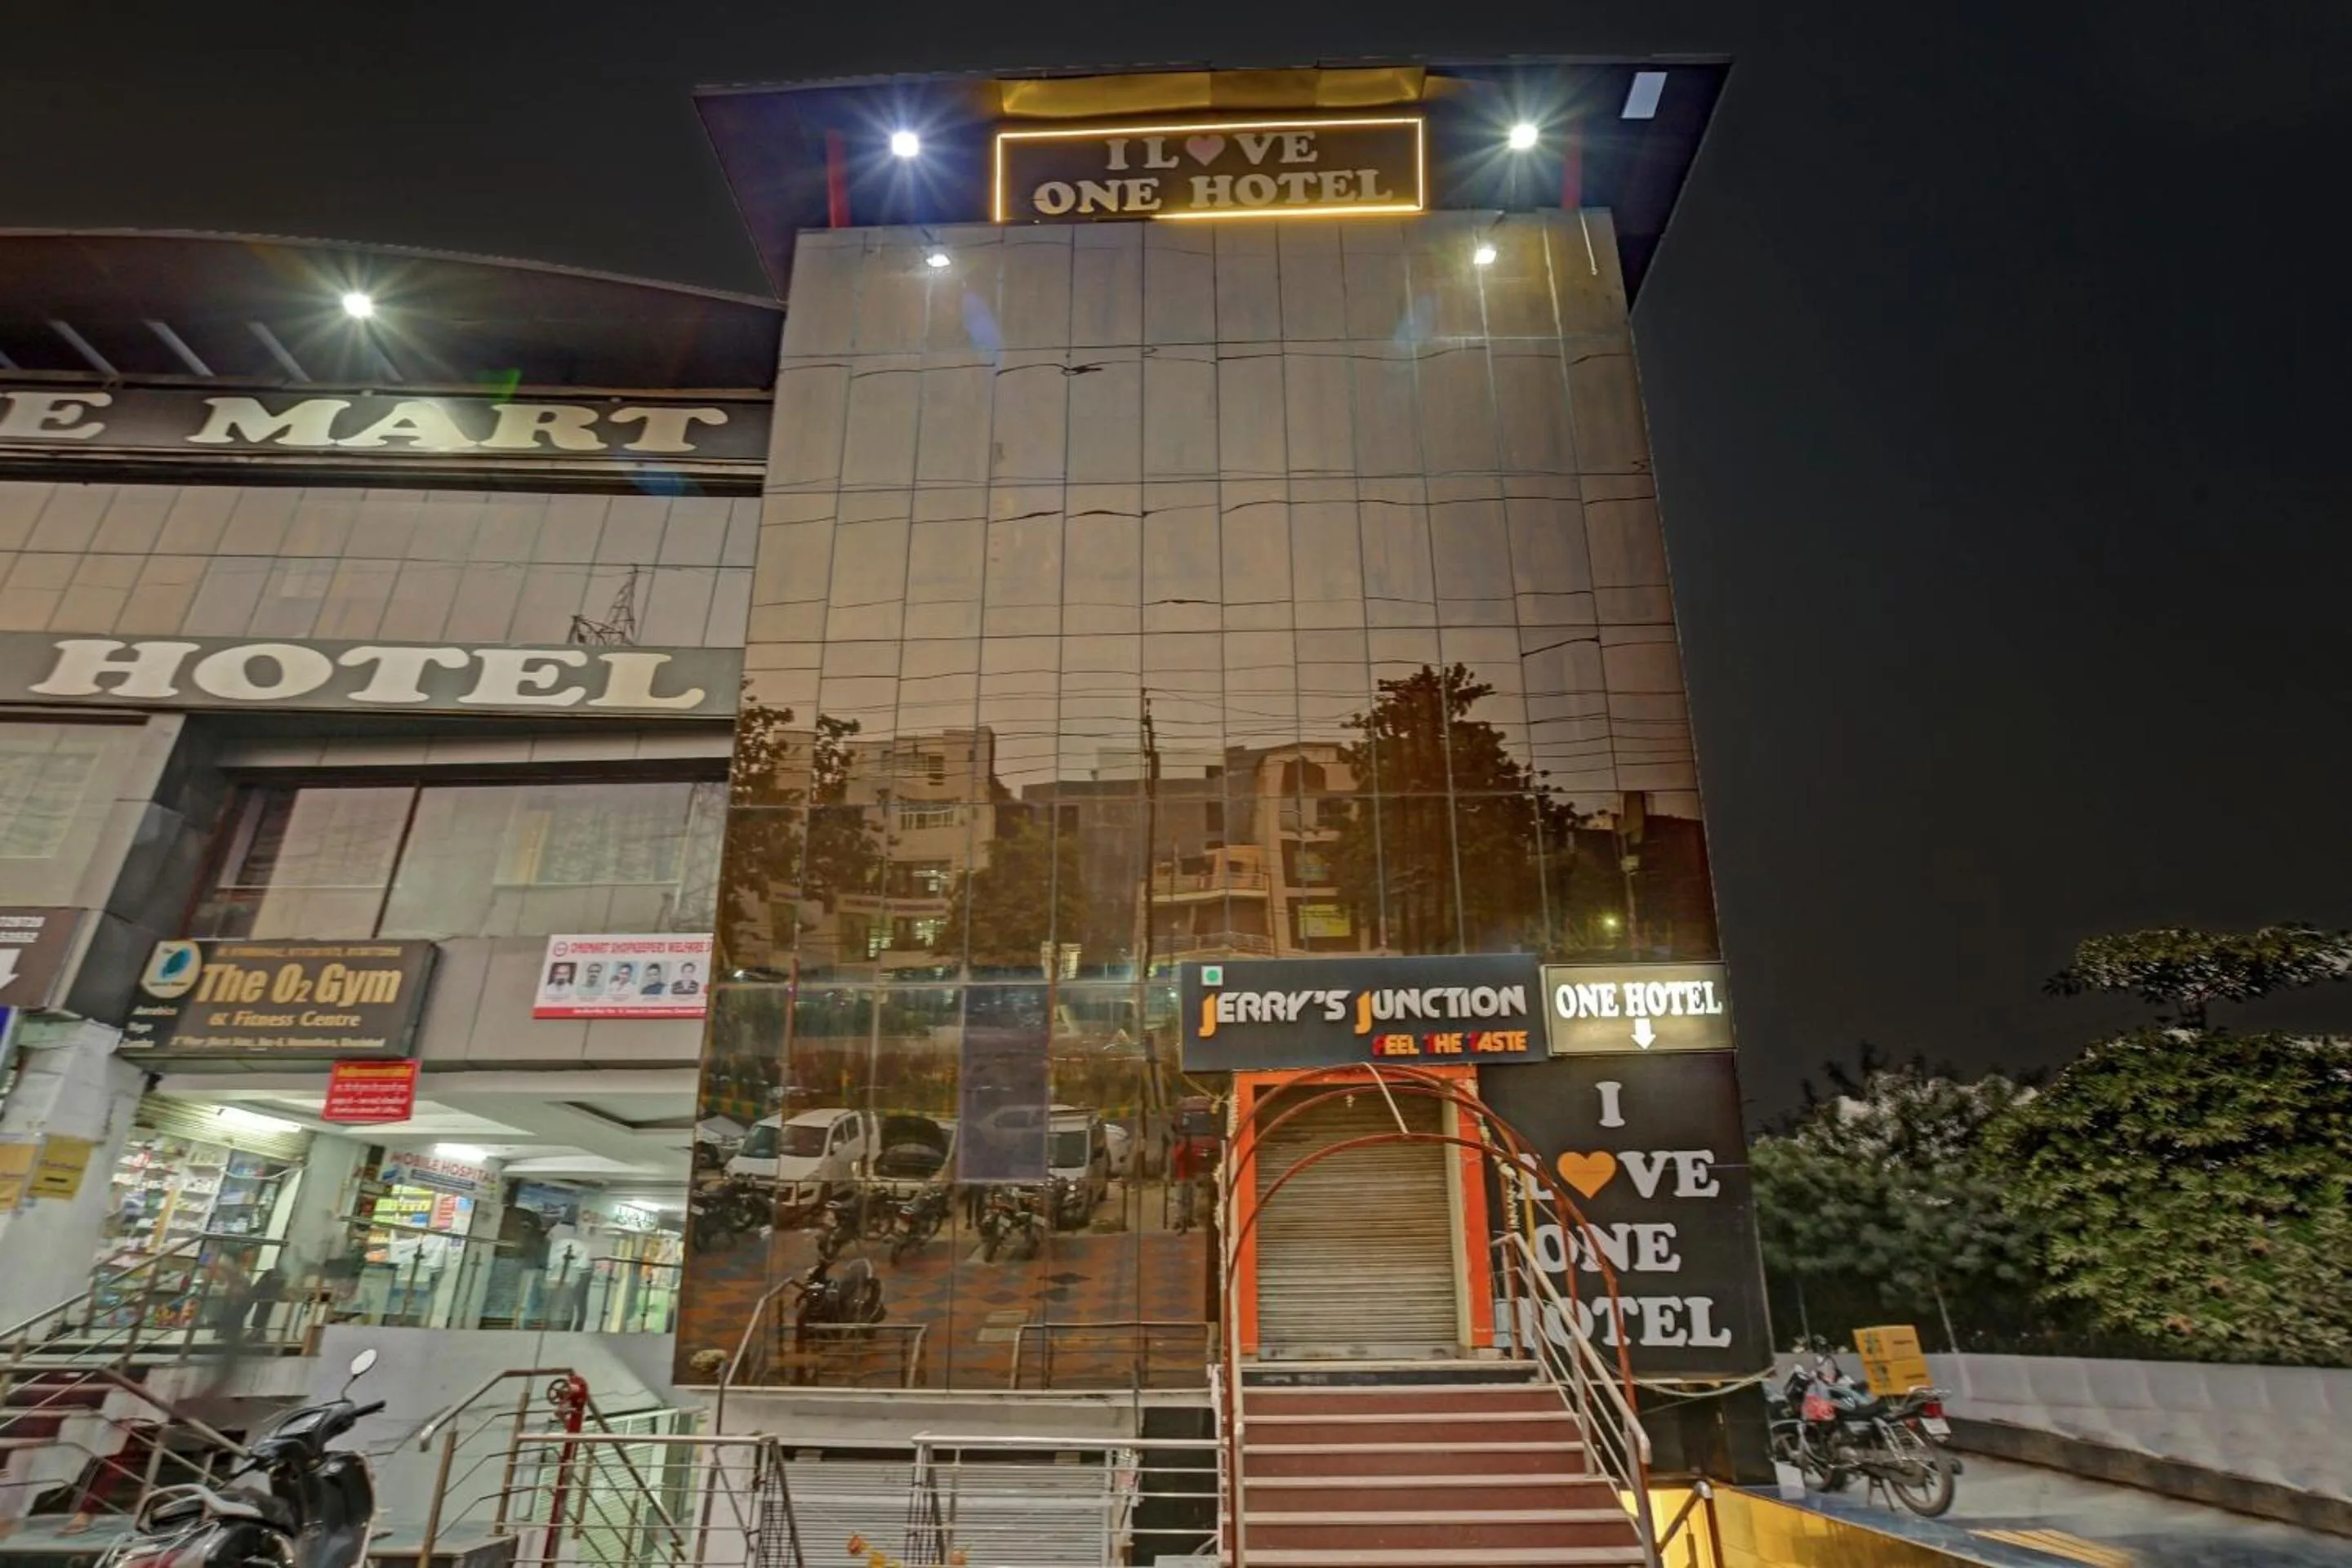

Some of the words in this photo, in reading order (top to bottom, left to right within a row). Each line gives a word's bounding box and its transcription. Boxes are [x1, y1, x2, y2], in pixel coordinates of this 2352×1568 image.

[1105, 137, 1129, 170] I
[1034, 177, 1161, 214] ONE
[1190, 169, 1392, 207] HOTEL
[185, 397, 729, 453] MART
[29, 640, 706, 710] HOTEL
[196, 964, 268, 1003] The
[314, 963, 402, 1007] Gym
[1555, 983, 1619, 1019] ONE
[1624, 981, 1723, 1017] HOTEL
[233, 1011, 295, 1027] Fitness
[300, 1011, 362, 1027] Centre
[1198, 990, 1352, 1037] JERRY'S
[1354, 986, 1527, 1035] JUNCTION
[1372, 1033, 1419, 1056] FEEL
[1423, 1031, 1464, 1054] THE
[1468, 1031, 1529, 1053] TASTE
[1595, 1081, 1625, 1127] I
[1535, 1223, 1682, 1272] ONE
